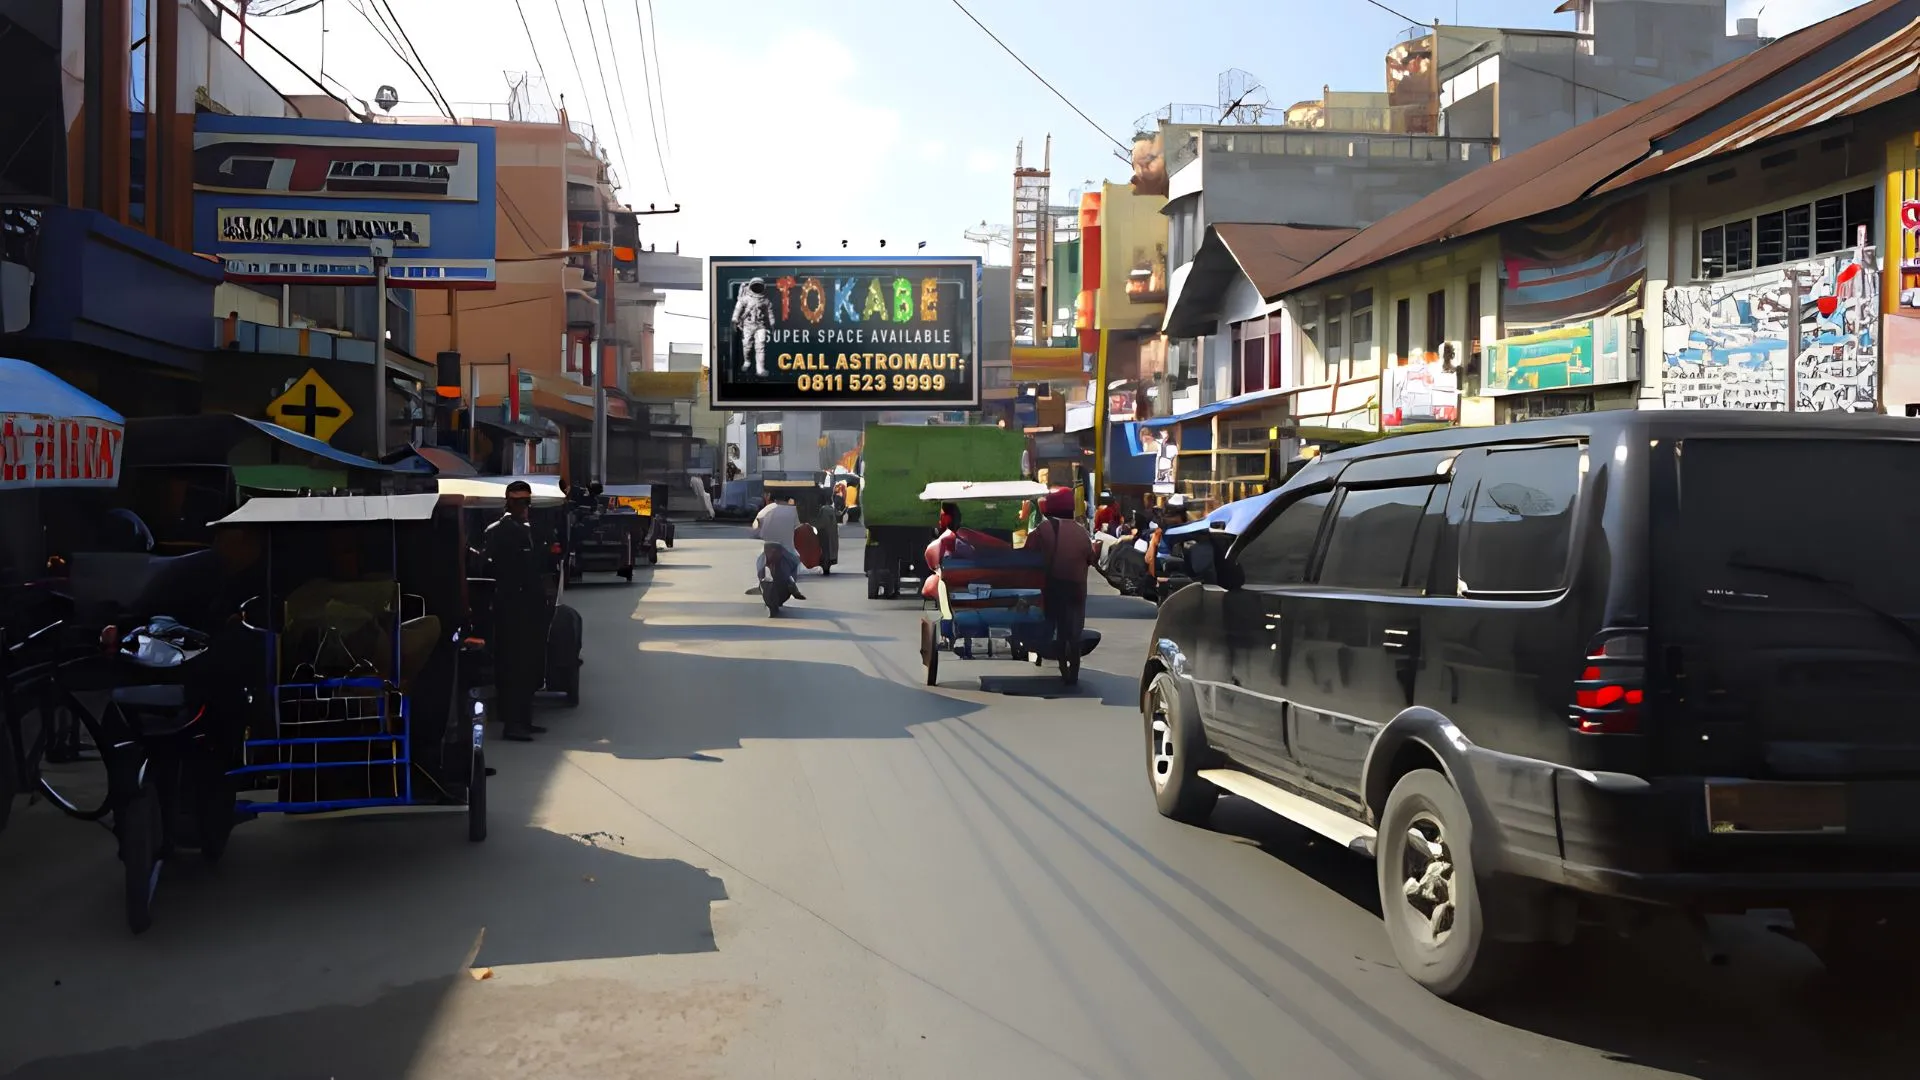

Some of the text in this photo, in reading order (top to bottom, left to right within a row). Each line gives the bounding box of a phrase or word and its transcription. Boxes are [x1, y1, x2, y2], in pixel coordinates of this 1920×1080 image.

[776, 275, 938, 323] TOKABE
[765, 329, 951, 343] SUPER SPACE AVAILABLE
[777, 353, 965, 370] CALL ASTRONAUT:
[797, 374, 946, 392] 0811 523 9999
